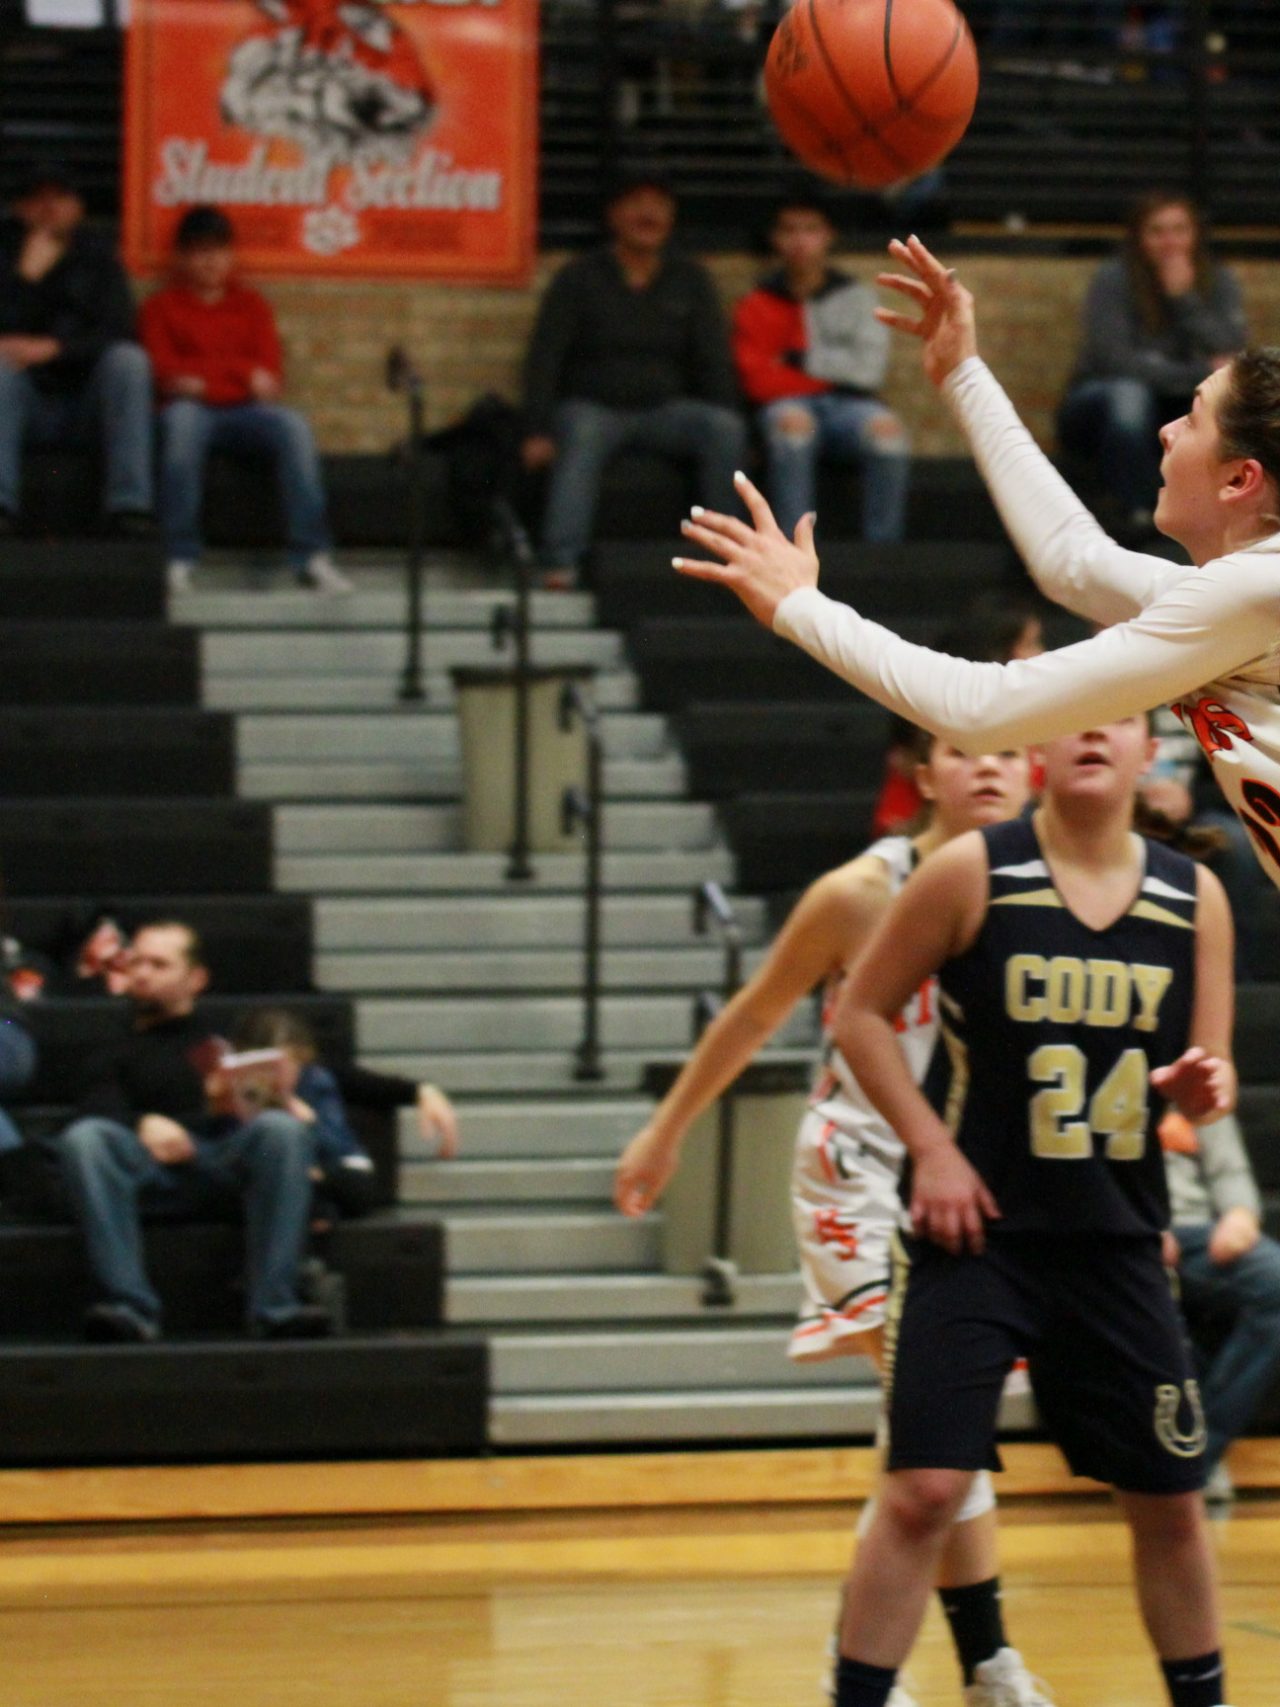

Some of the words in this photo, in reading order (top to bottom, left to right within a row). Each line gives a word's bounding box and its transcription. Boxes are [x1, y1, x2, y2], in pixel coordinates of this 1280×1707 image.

[153, 138, 334, 206] Student
[343, 138, 501, 211] Section
[1006, 954, 1173, 1032] CODY
[1028, 1044, 1150, 1160] 24
